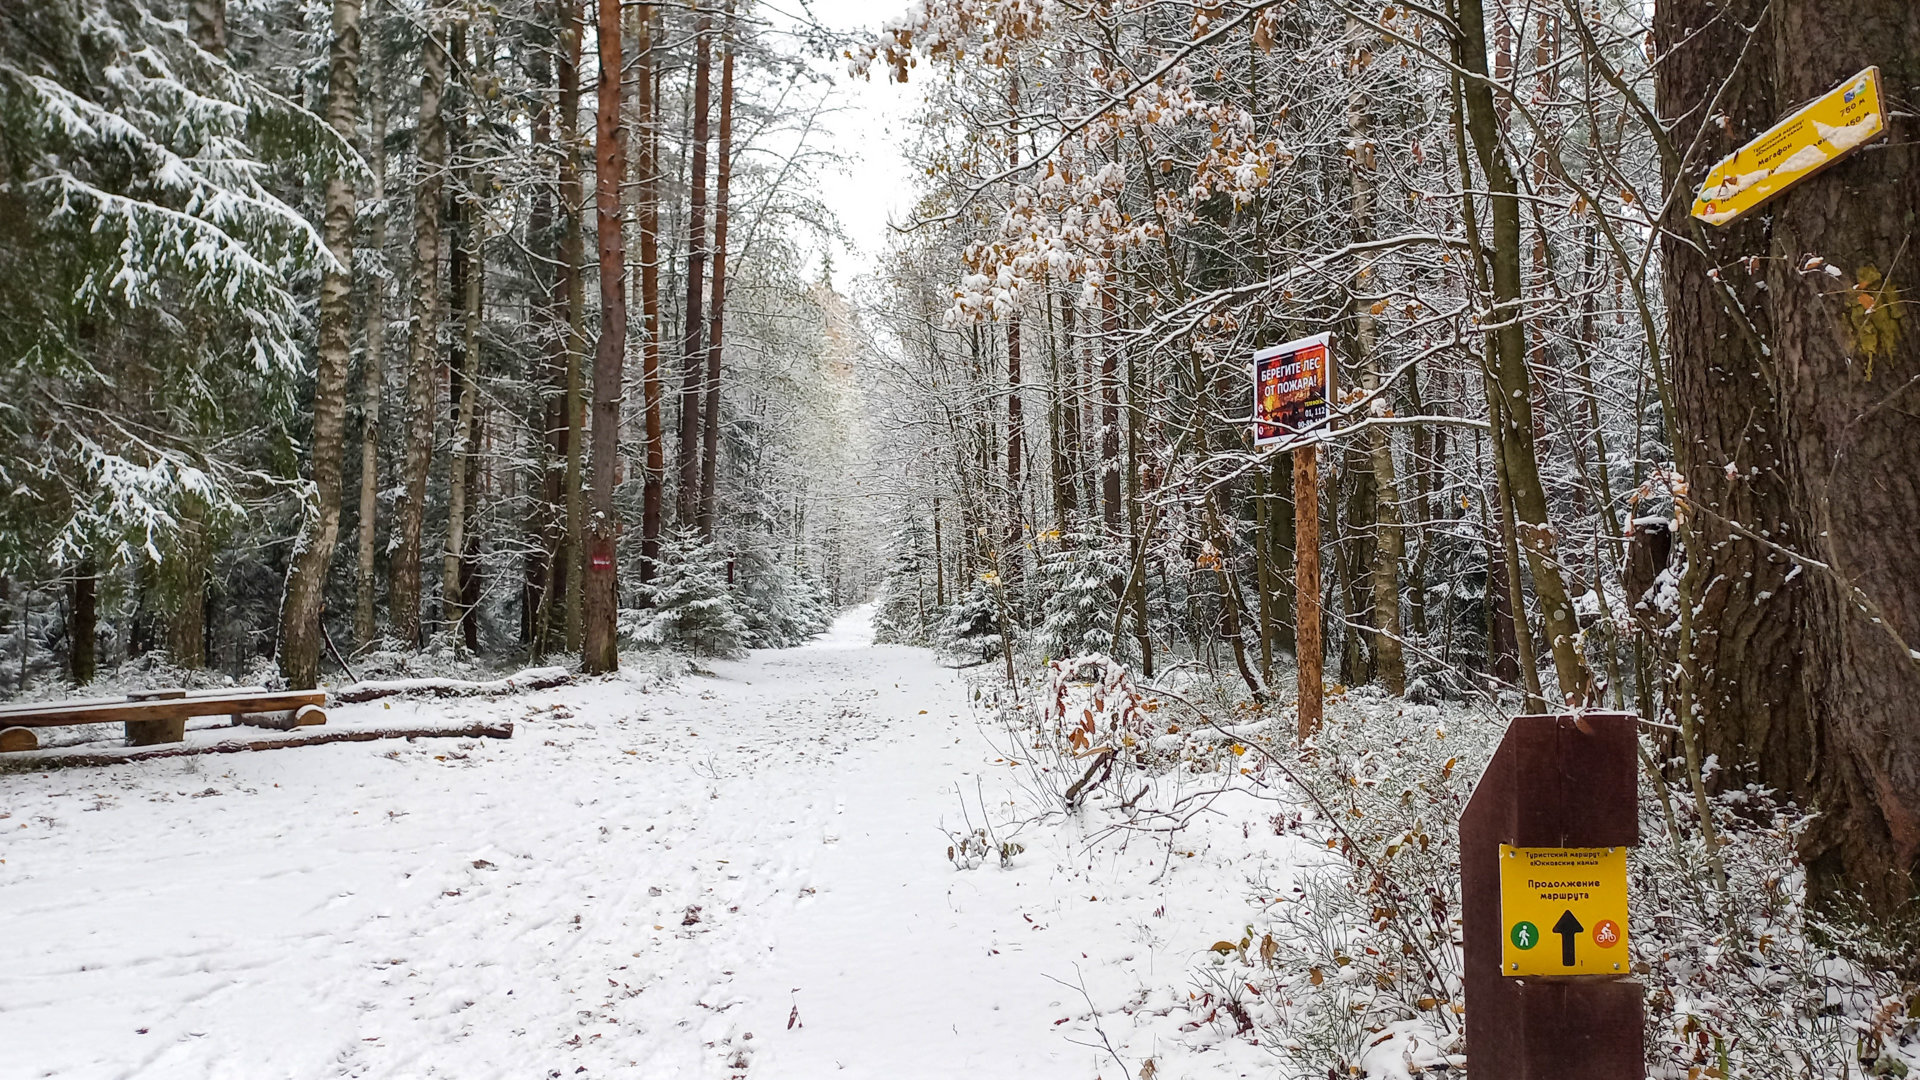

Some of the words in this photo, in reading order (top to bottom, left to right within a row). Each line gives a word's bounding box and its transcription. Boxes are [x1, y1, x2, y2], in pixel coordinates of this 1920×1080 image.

[1839, 102, 1857, 117] 750
[1757, 143, 1793, 167] Мегафон
[1261, 361, 1301, 382] БЕРЕГИТЕ
[1302, 356, 1321, 372] ЛЕС
[1264, 384, 1276, 397] ОТ
[1277, 374, 1317, 395] ПОЖАРА!
[1314, 406, 1326, 416] 112
[1525, 851, 1568, 859] Туристский
[1570, 851, 1600, 859] маршрут
[1528, 879, 1601, 890] Продолжение
[1540, 891, 1590, 901] маршрута
